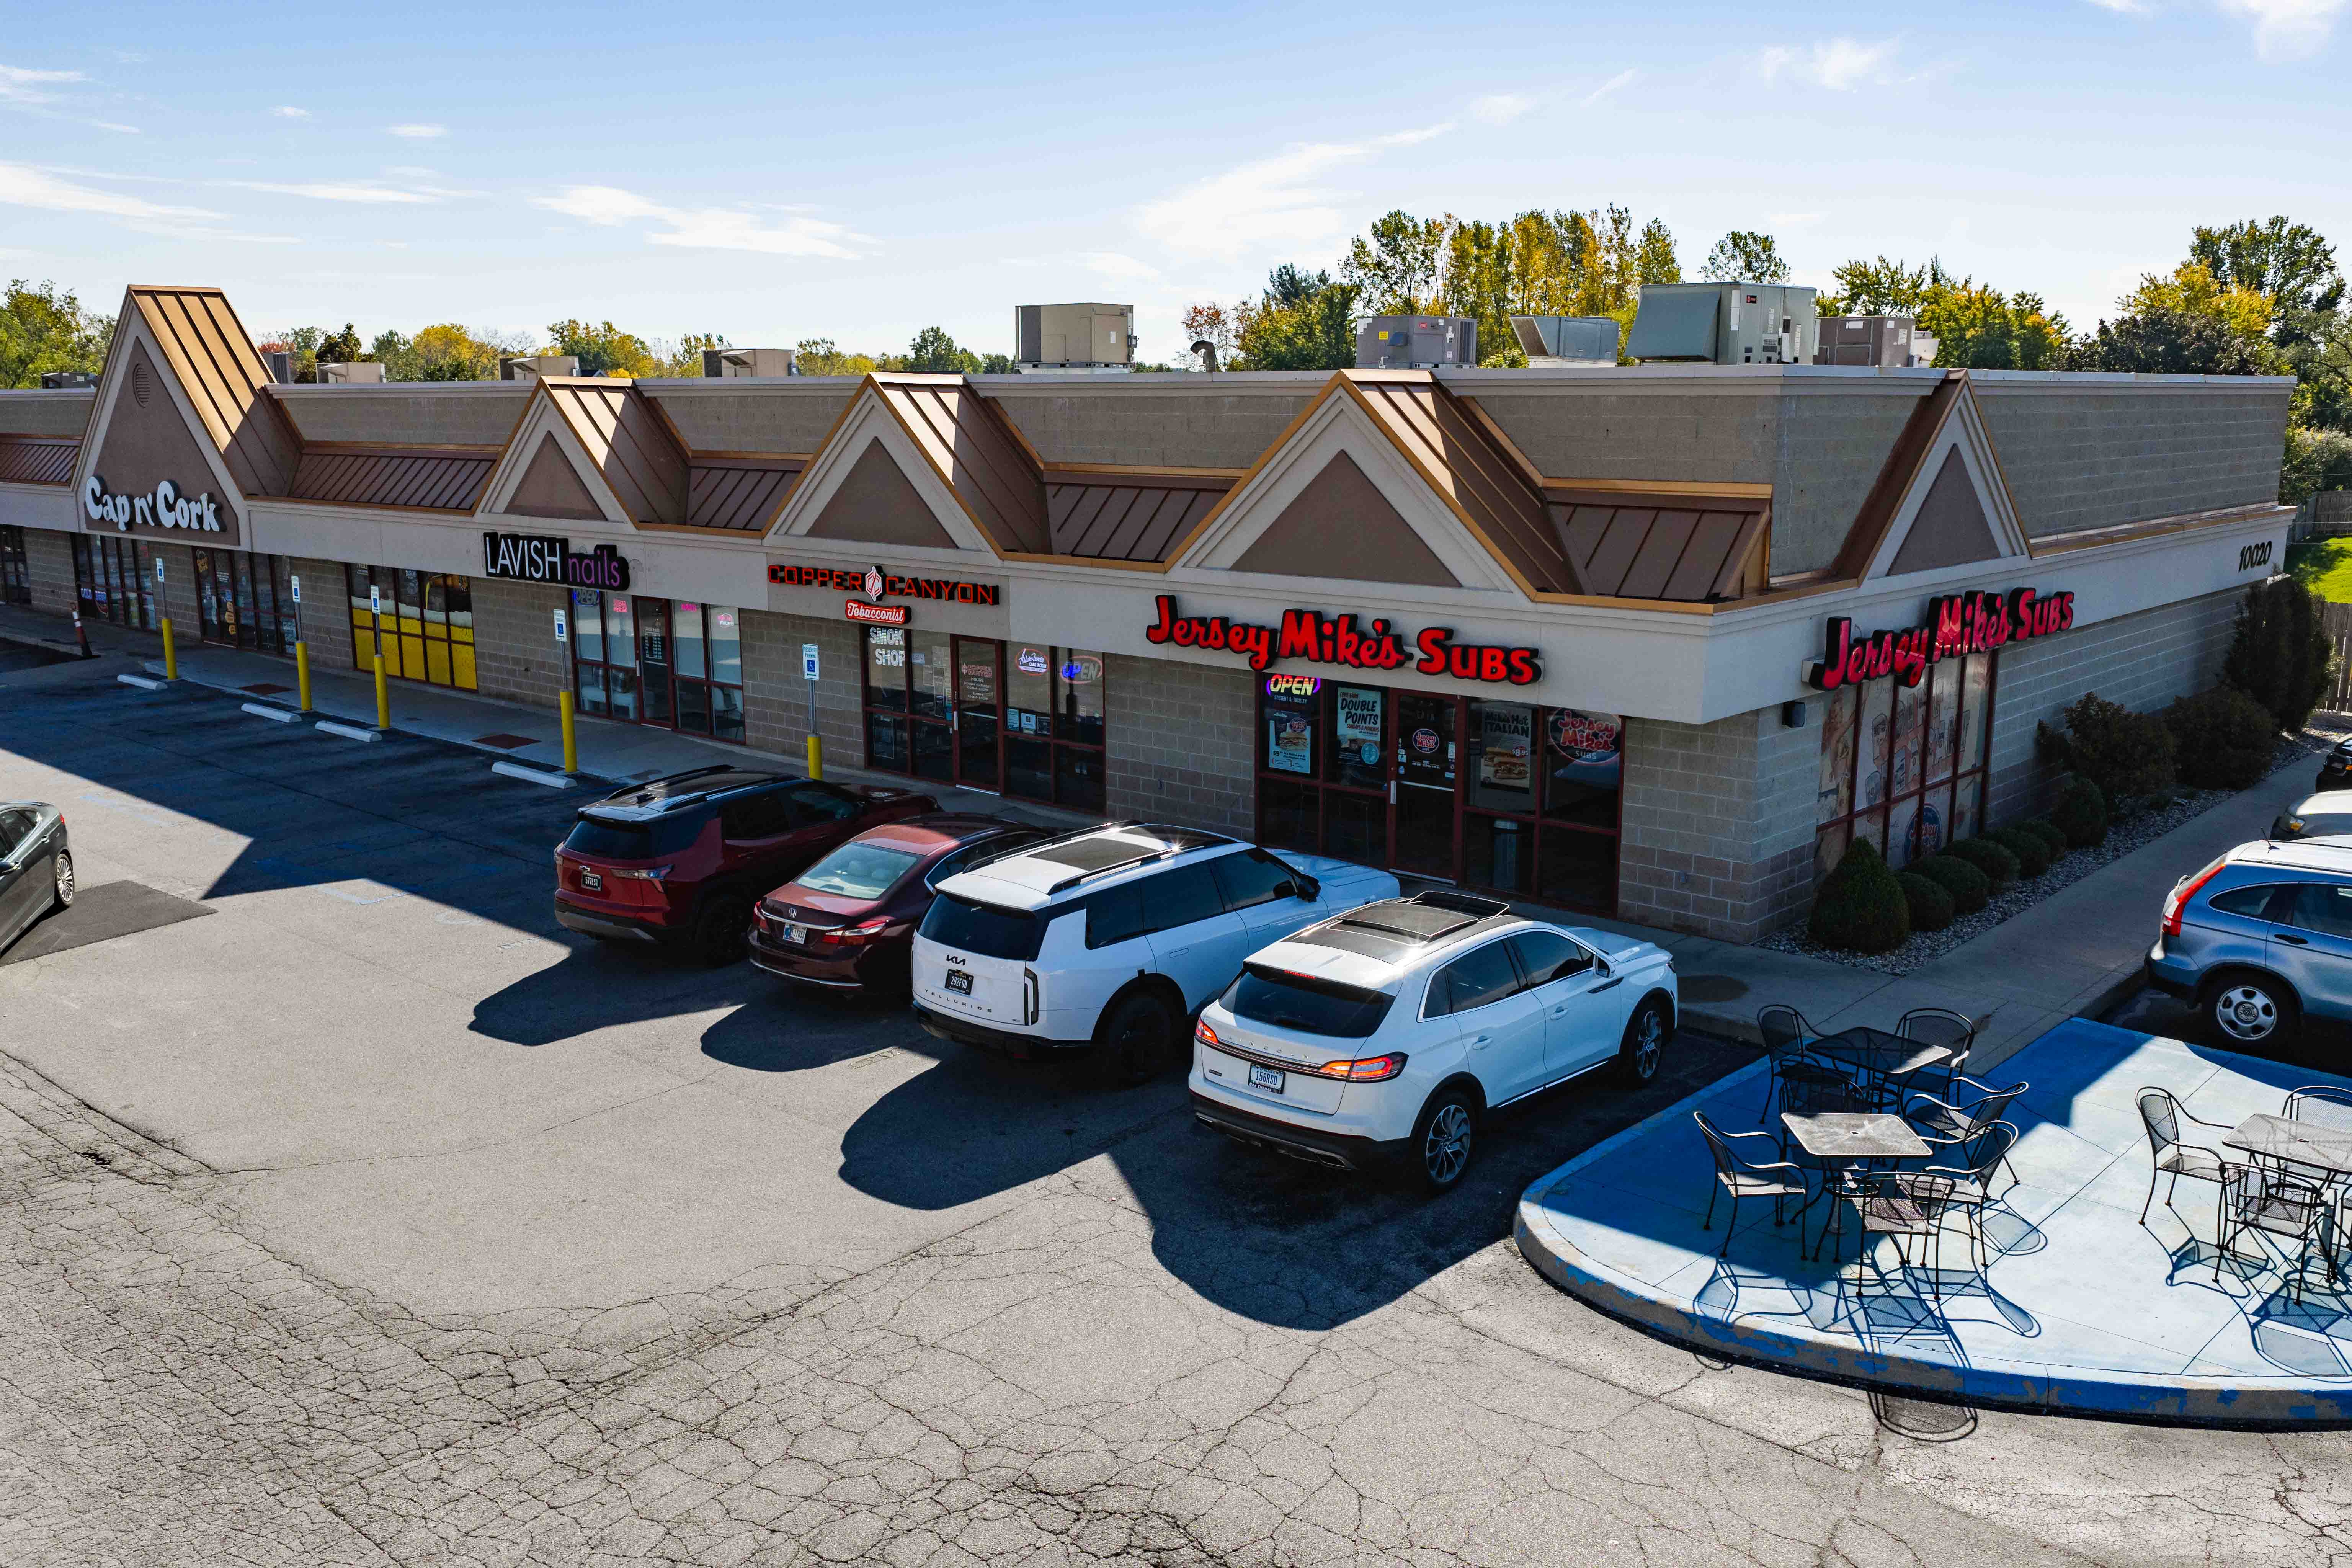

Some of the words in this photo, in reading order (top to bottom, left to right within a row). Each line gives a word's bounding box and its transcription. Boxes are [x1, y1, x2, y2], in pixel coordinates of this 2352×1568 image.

[85, 476, 130, 531] Cap
[157, 481, 219, 532] Cork
[486, 537, 560, 580] LAVISH
[568, 550, 620, 587] nails
[2239, 541, 2272, 572] 10020
[768, 565, 862, 591] COPPER
[886, 576, 994, 605] CANYON
[847, 602, 904, 622] Tobacconist
[1147, 596, 1274, 670] Jersey
[1278, 609, 1412, 670] Mike's
[1820, 619, 1929, 689] Jersey
[1932, 593, 2012, 662] Mike's
[875, 648, 905, 667] SHOP
[1062, 661, 1098, 680] OPEN
[1270, 674, 1315, 696] OPEN
[1340, 698, 1377, 712] DOUBLE
[1345, 711, 1379, 725] POINTS
[1558, 710, 1616, 741] Jersey
[1416, 732, 1436, 741] Jersey
[1485, 722, 1529, 738] ITALIAN
[1575, 751, 1596, 760] SUBS
[925, 989, 992, 1013] TELLURIDE
[1229, 1034, 1308, 1060] LINCOLN
[1256, 1071, 1277, 1085] 156RSD
[1258, 1084, 1272, 1092] THOMAS
